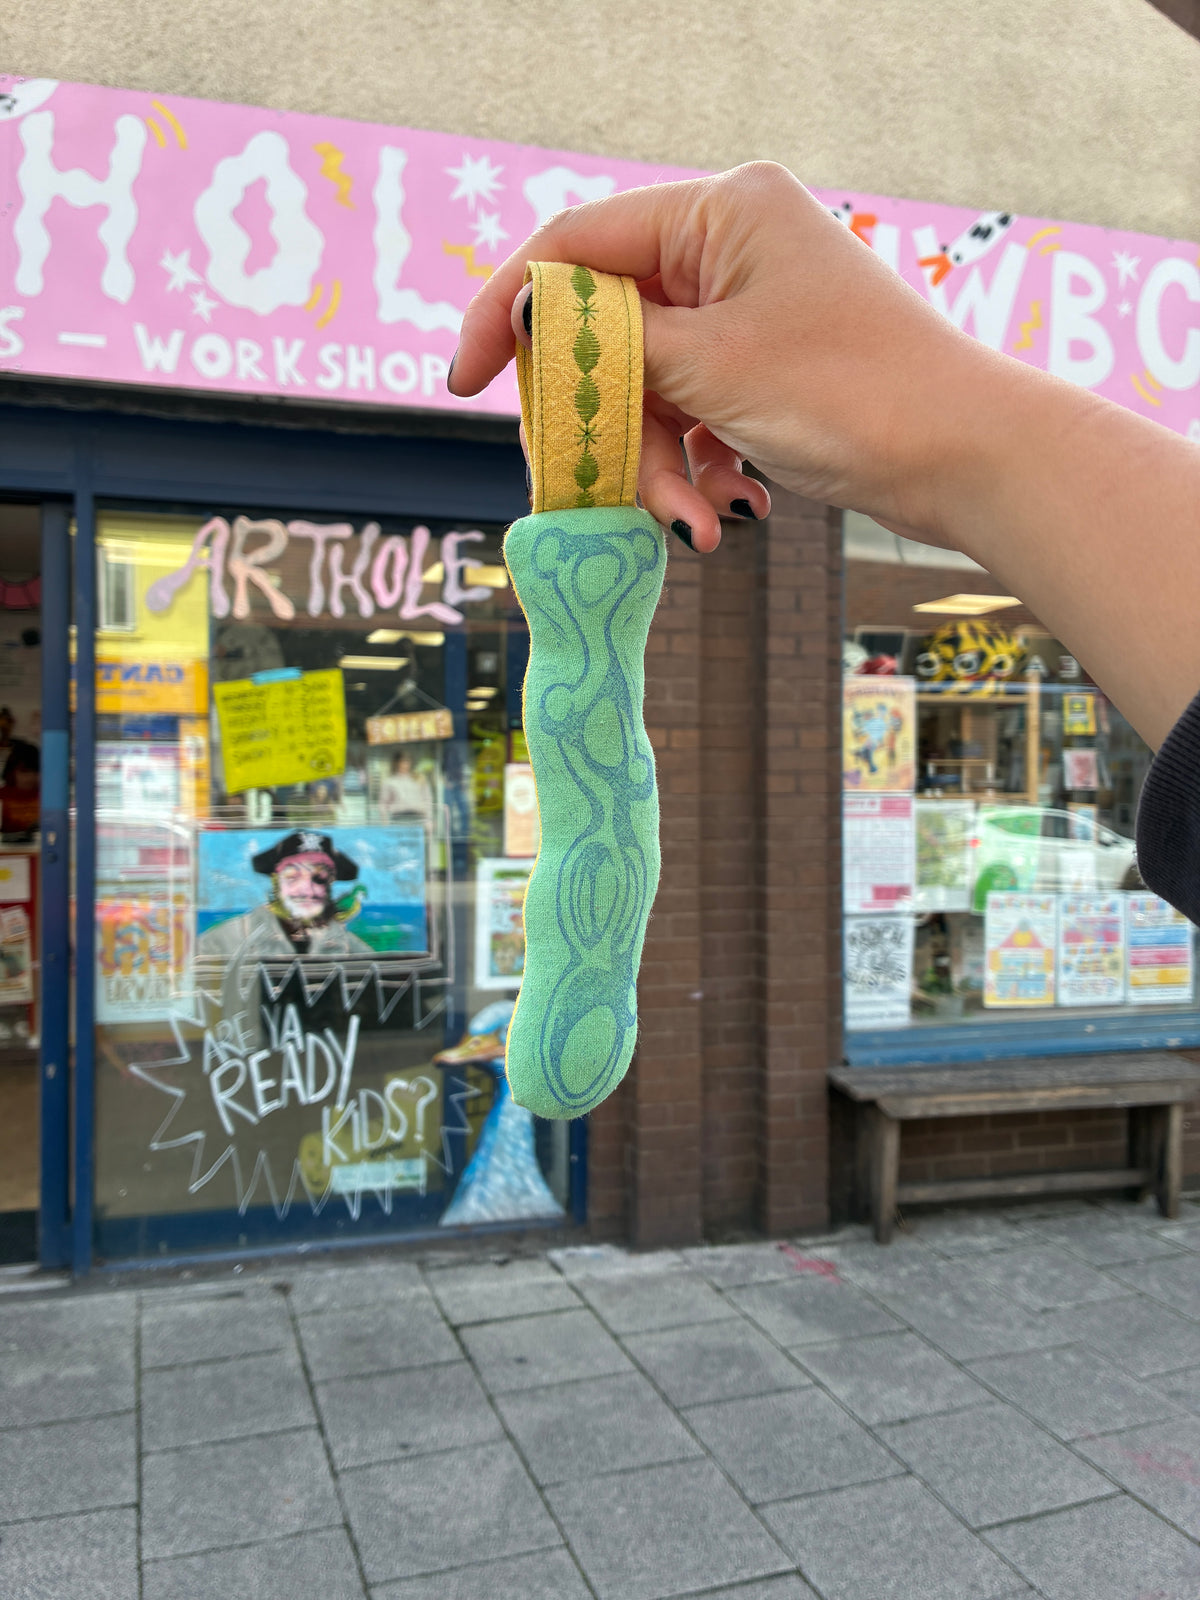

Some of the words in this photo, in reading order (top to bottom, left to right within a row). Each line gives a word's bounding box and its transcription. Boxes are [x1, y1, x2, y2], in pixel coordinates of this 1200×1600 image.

[14, 110, 617, 332] HOL
[133, 322, 480, 401] WORKSHOP
[203, 1010, 256, 1074] ARE
[260, 1003, 305, 1051] YA
[210, 1014, 360, 1136] READY
[322, 1076, 438, 1167] KIDS?
